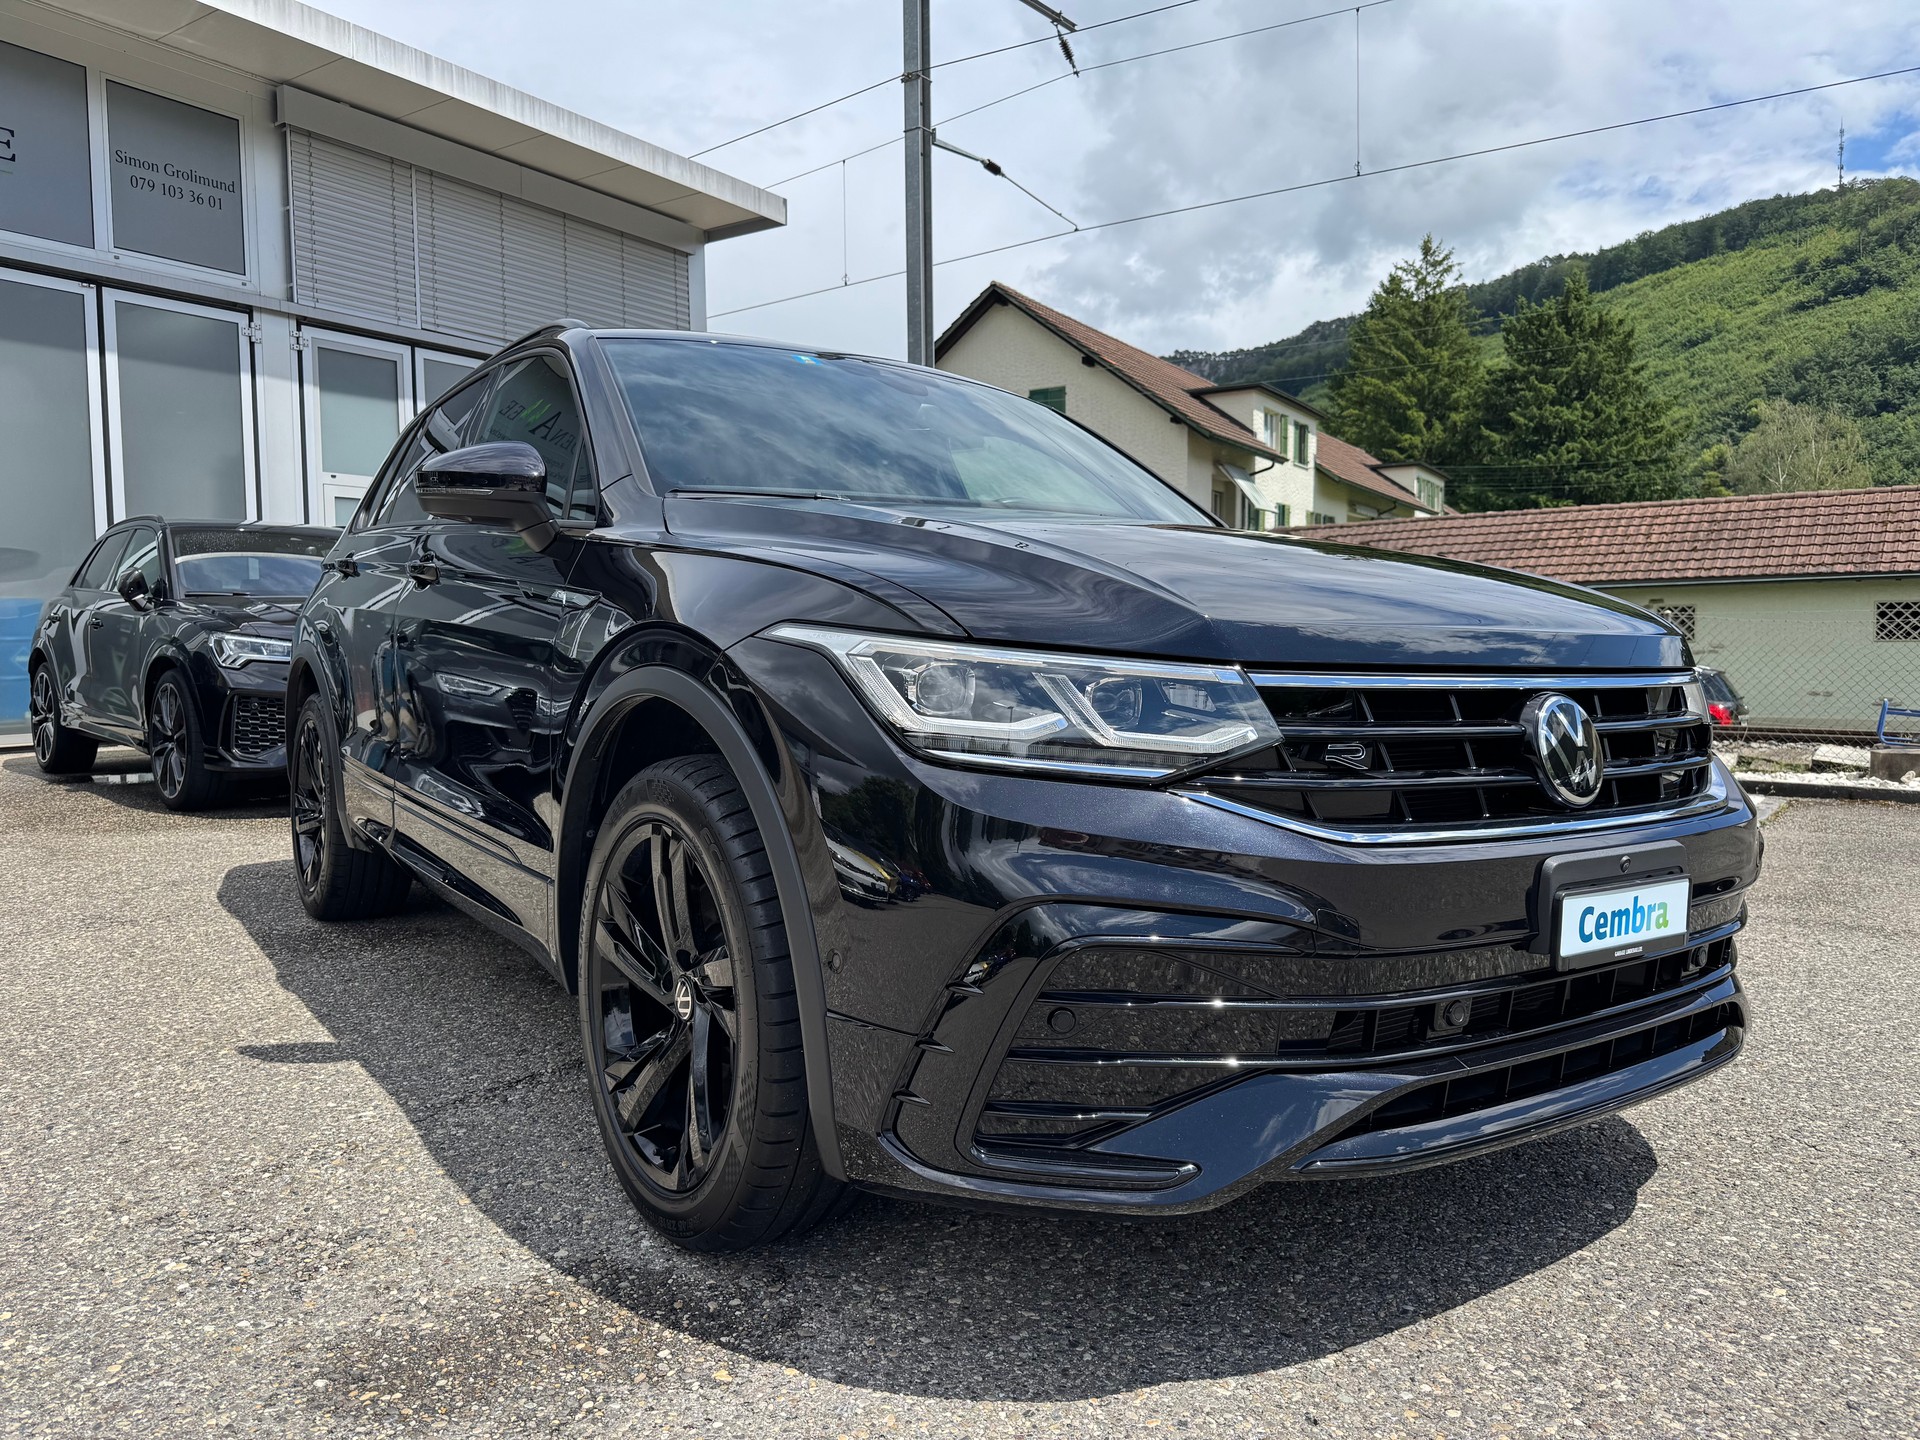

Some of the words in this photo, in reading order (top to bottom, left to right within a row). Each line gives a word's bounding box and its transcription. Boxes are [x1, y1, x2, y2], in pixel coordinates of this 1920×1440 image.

[115, 150, 159, 174] Simon
[163, 162, 236, 194] Grolimund
[130, 175, 156, 192] 079
[161, 183, 184, 200] 103
[189, 190, 205, 206] 36
[208, 195, 223, 210] 01
[1325, 743, 1369, 770] R
[1578, 895, 1669, 944] Cembra
